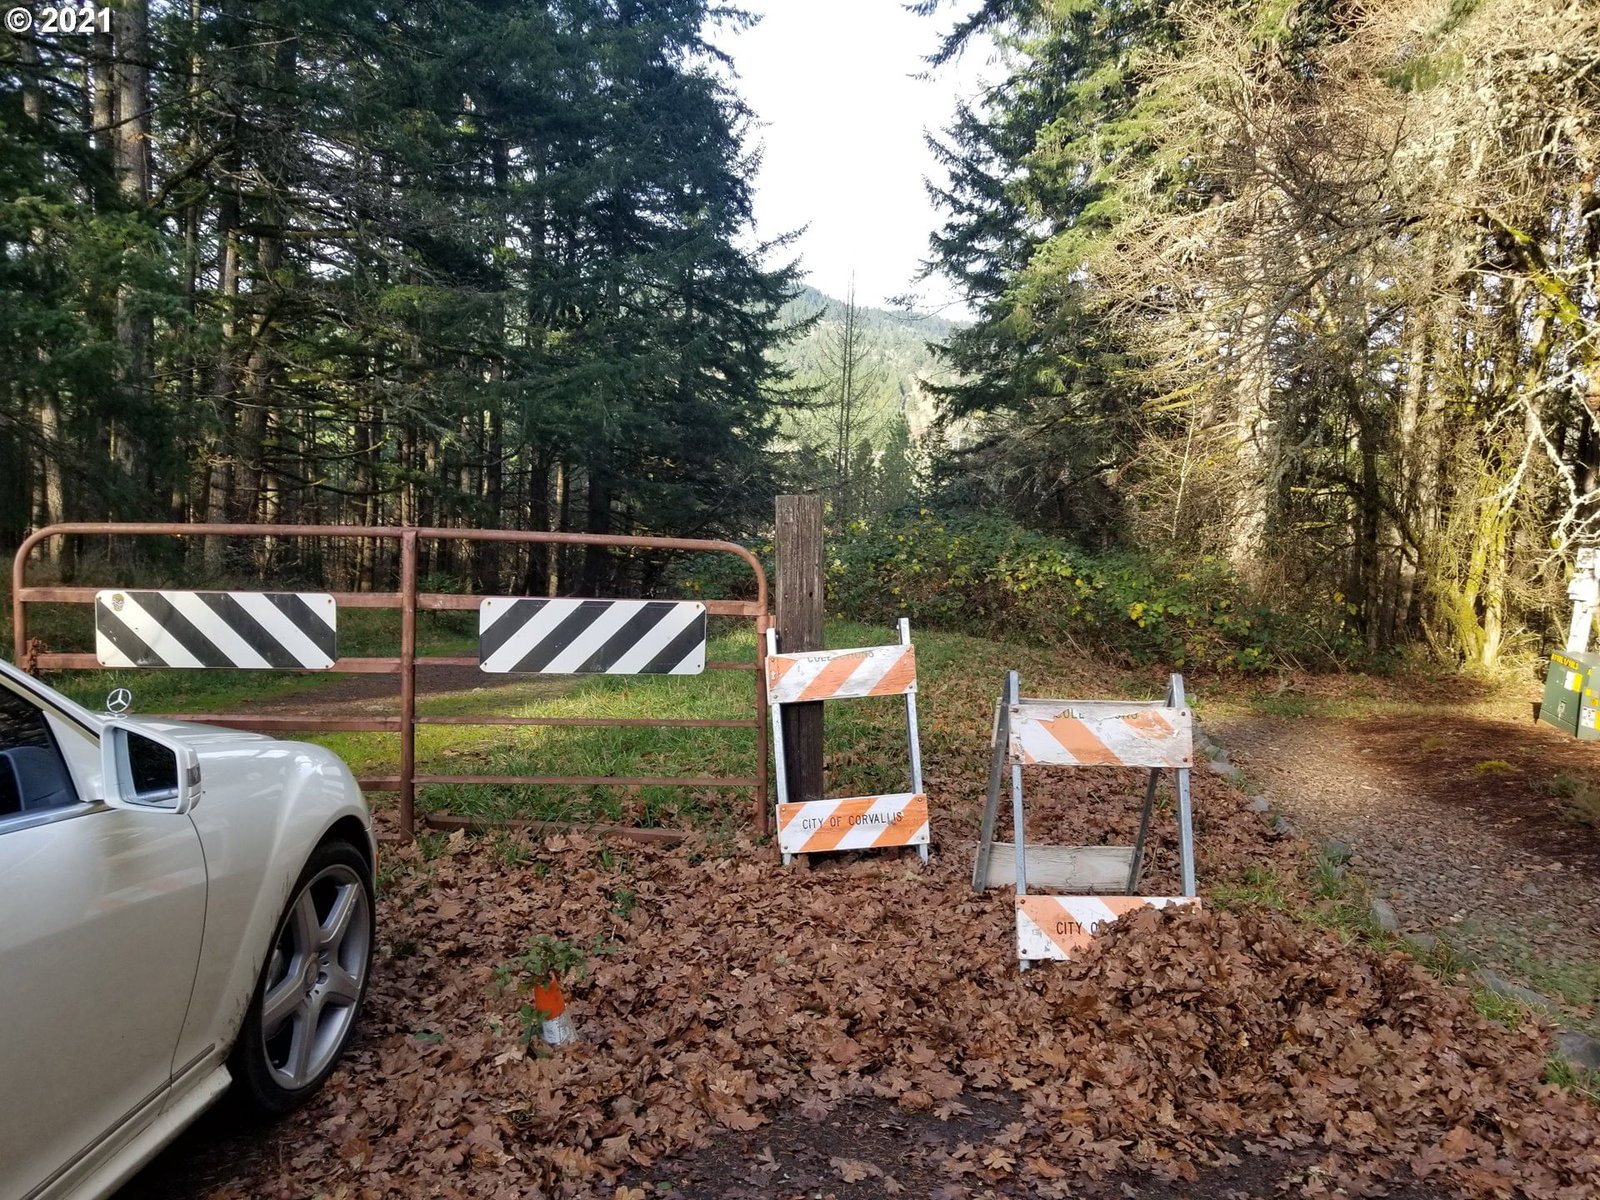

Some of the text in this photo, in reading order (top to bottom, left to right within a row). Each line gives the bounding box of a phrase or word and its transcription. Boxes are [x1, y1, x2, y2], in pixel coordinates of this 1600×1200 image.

[802, 811, 903, 830] CITY OF CORVALLIS
[1056, 921, 1083, 935] CITY
